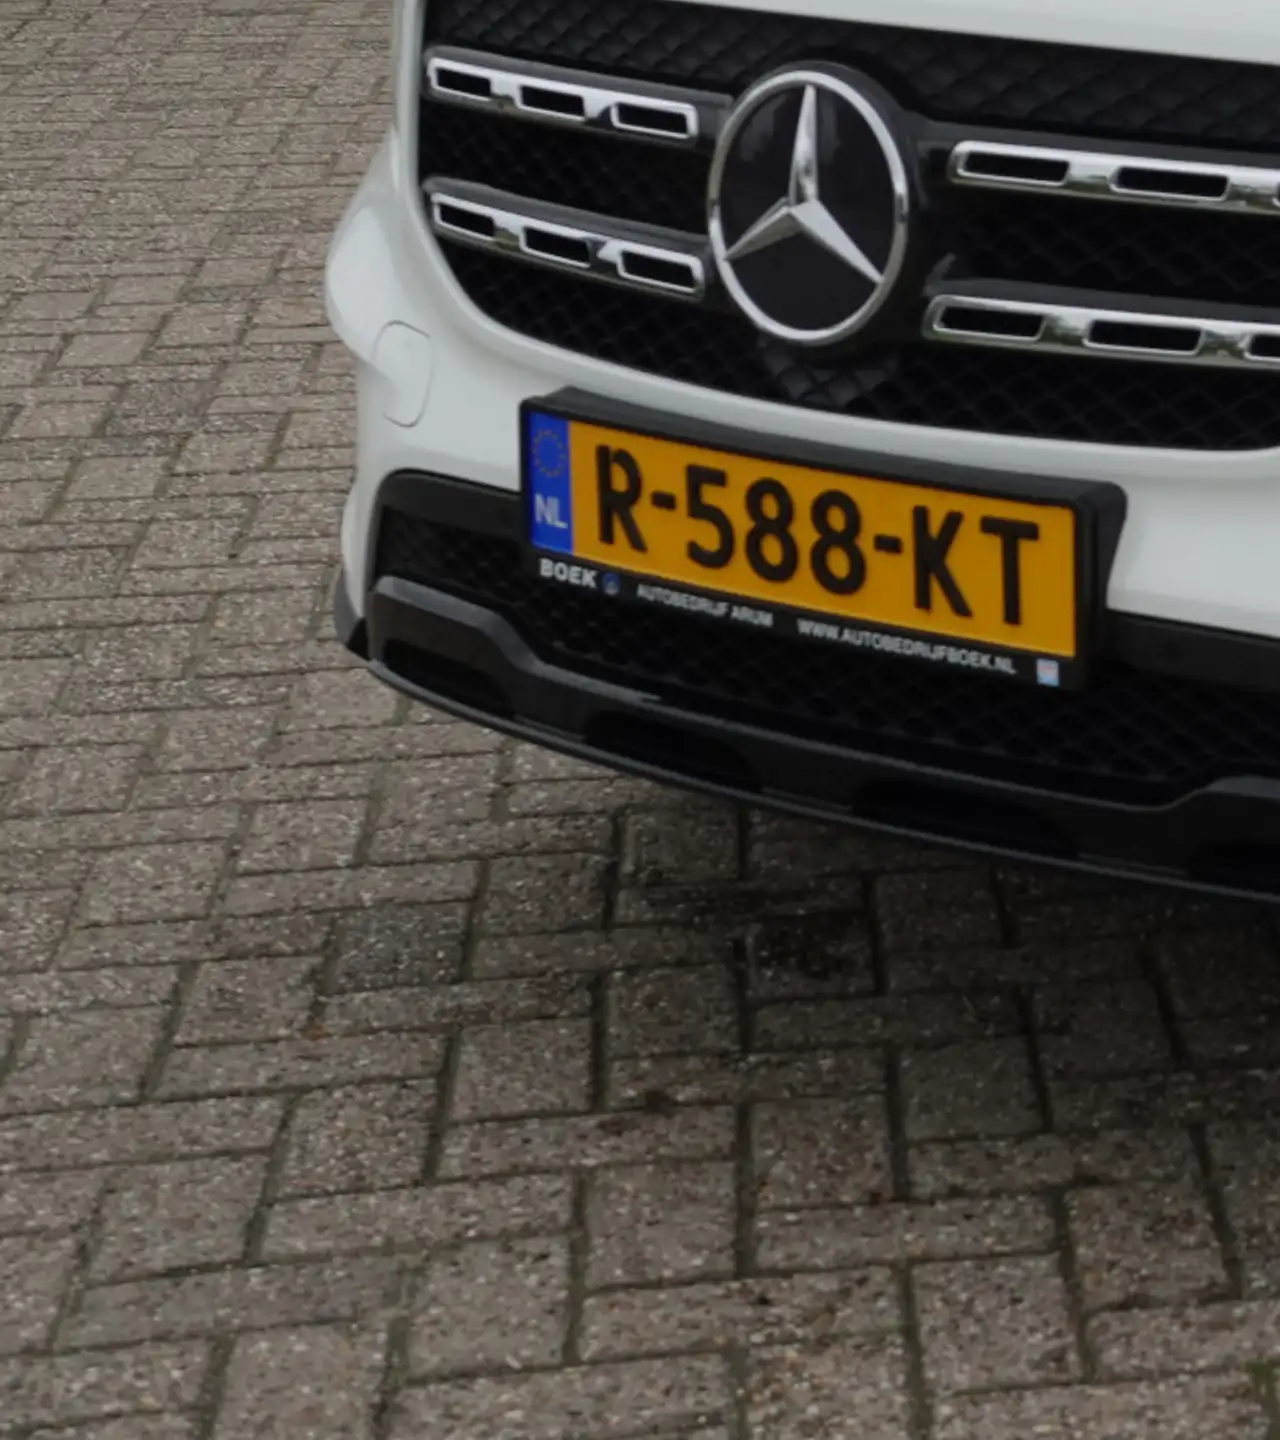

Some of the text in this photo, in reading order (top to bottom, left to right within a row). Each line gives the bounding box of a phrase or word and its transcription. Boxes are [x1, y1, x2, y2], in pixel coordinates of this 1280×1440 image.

[534, 494, 568, 529] NL
[595, 444, 1039, 626] R-588-KT
[539, 558, 597, 588] BOEK
[636, 583, 1018, 675] AUTOBEDRIJF ARUM WWW.AUTOBEDRIJFBOEK.NL
